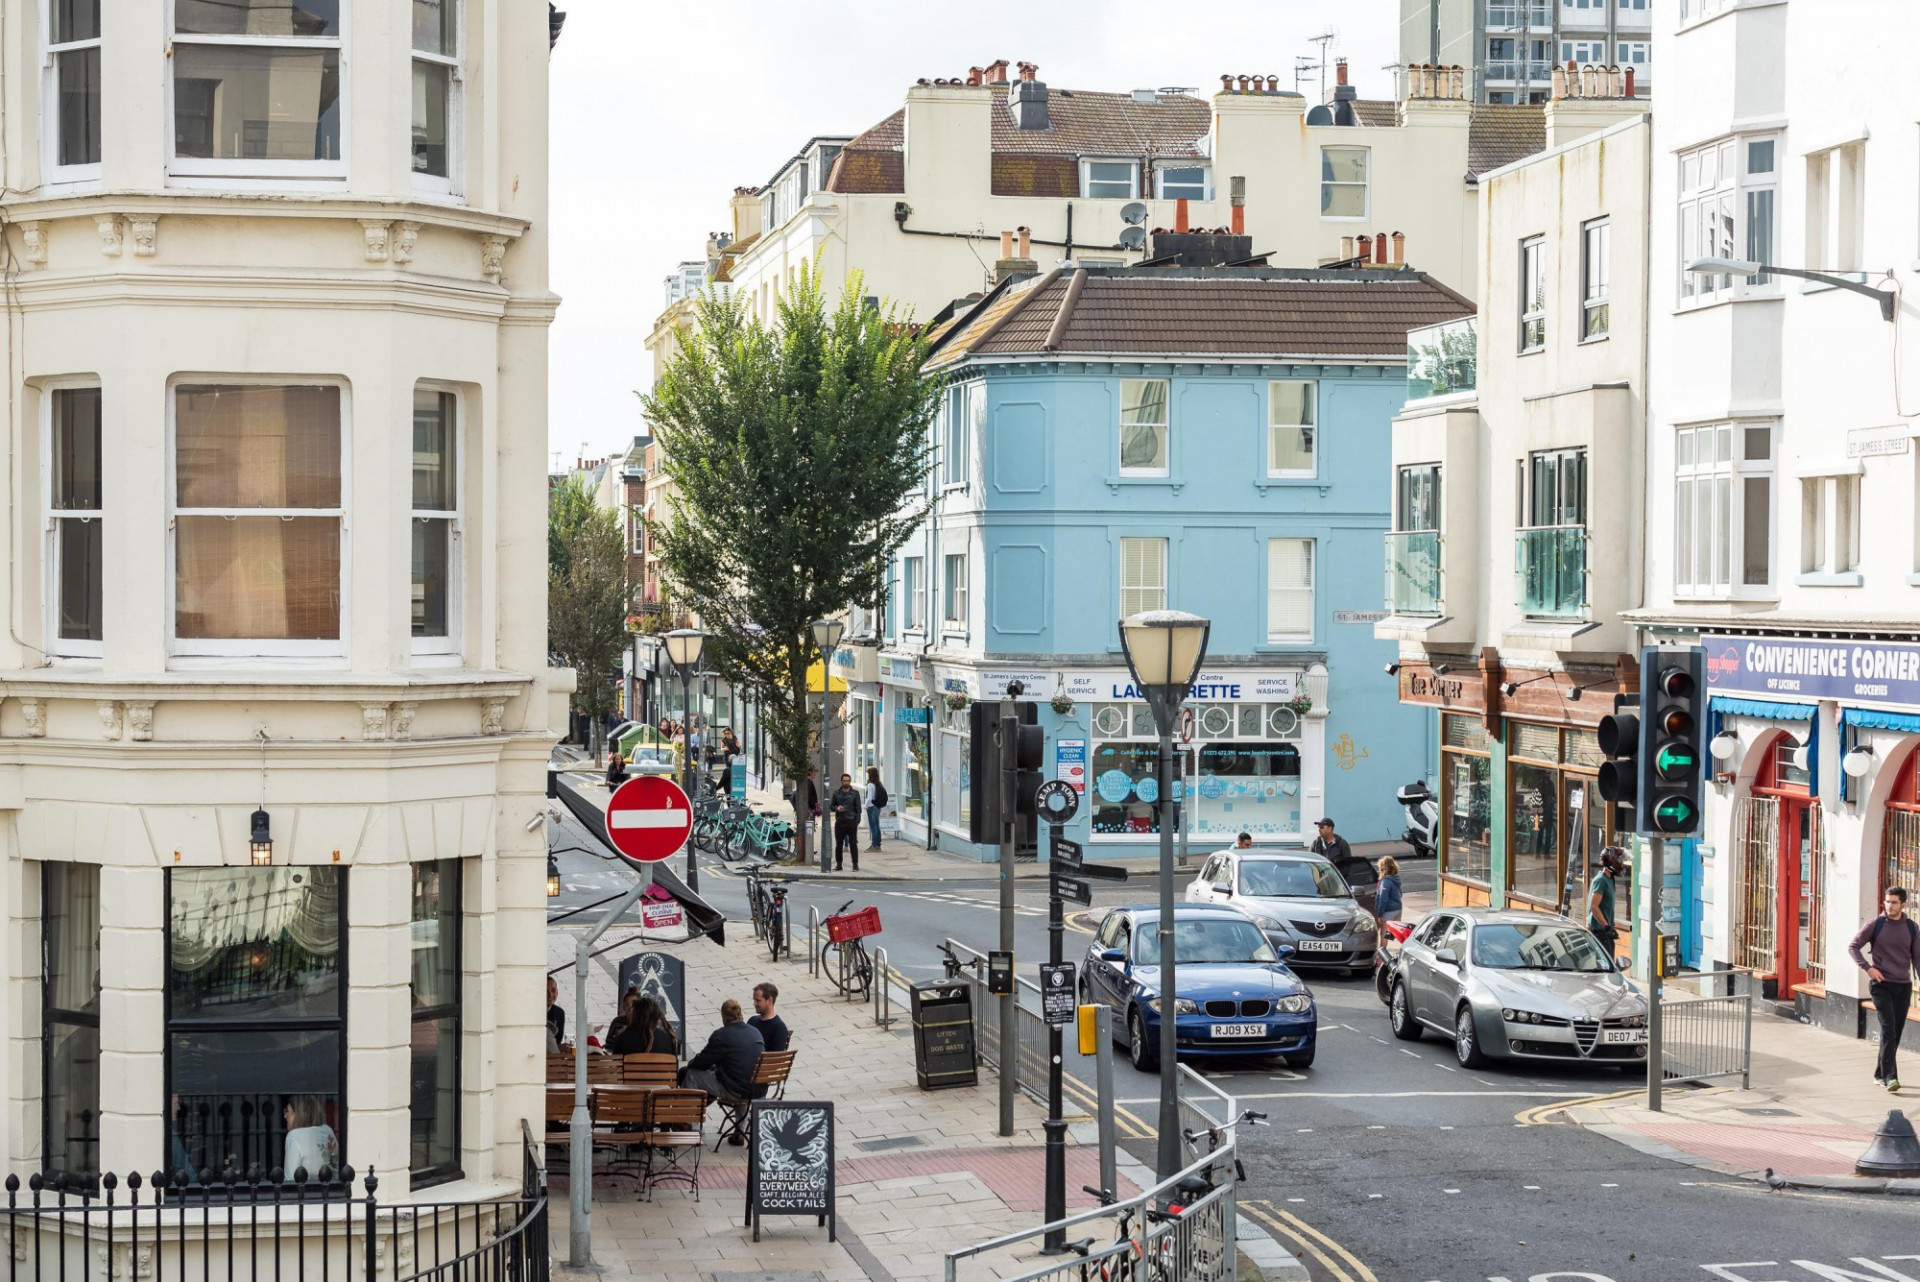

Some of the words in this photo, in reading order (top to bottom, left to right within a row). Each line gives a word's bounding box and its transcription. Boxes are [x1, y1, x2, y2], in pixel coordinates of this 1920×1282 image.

[1884, 437, 1906, 451] STREET
[1745, 642, 1847, 677] CONVENIENCE
[1851, 646, 1920, 682] CORNER
[1767, 678, 1777, 689] OFF
[1778, 679, 1801, 691] LICENCE
[1854, 683, 1888, 696] GROCERIES
[1112, 684, 1241, 698] LAURETTE
[894, 708, 924, 716] BETTER
[1038, 782, 1057, 808] KEMP
[1060, 783, 1076, 807] TOWN
[653, 919, 673, 927] OPEN
[1302, 942, 1323, 950] EA54
[936, 1030, 957, 1038] LITTER
[1215, 1025, 1241, 1035] RJ09
[1243, 1025, 1263, 1035] XSX
[1608, 1032, 1631, 1042] DE07
[930, 1045, 945, 1053] DOG
[945, 1043, 965, 1052] WASTE
[760, 1171, 779, 1181] NEW
[779, 1171, 809, 1181] BEERS
[760, 1181, 787, 1191] EVERY
[787, 1181, 812, 1191] WEEK
[781, 1191, 807, 1199] BELGIAN
[808, 1191, 825, 1199] ALES
[761, 1199, 827, 1208] COCKTAILS
